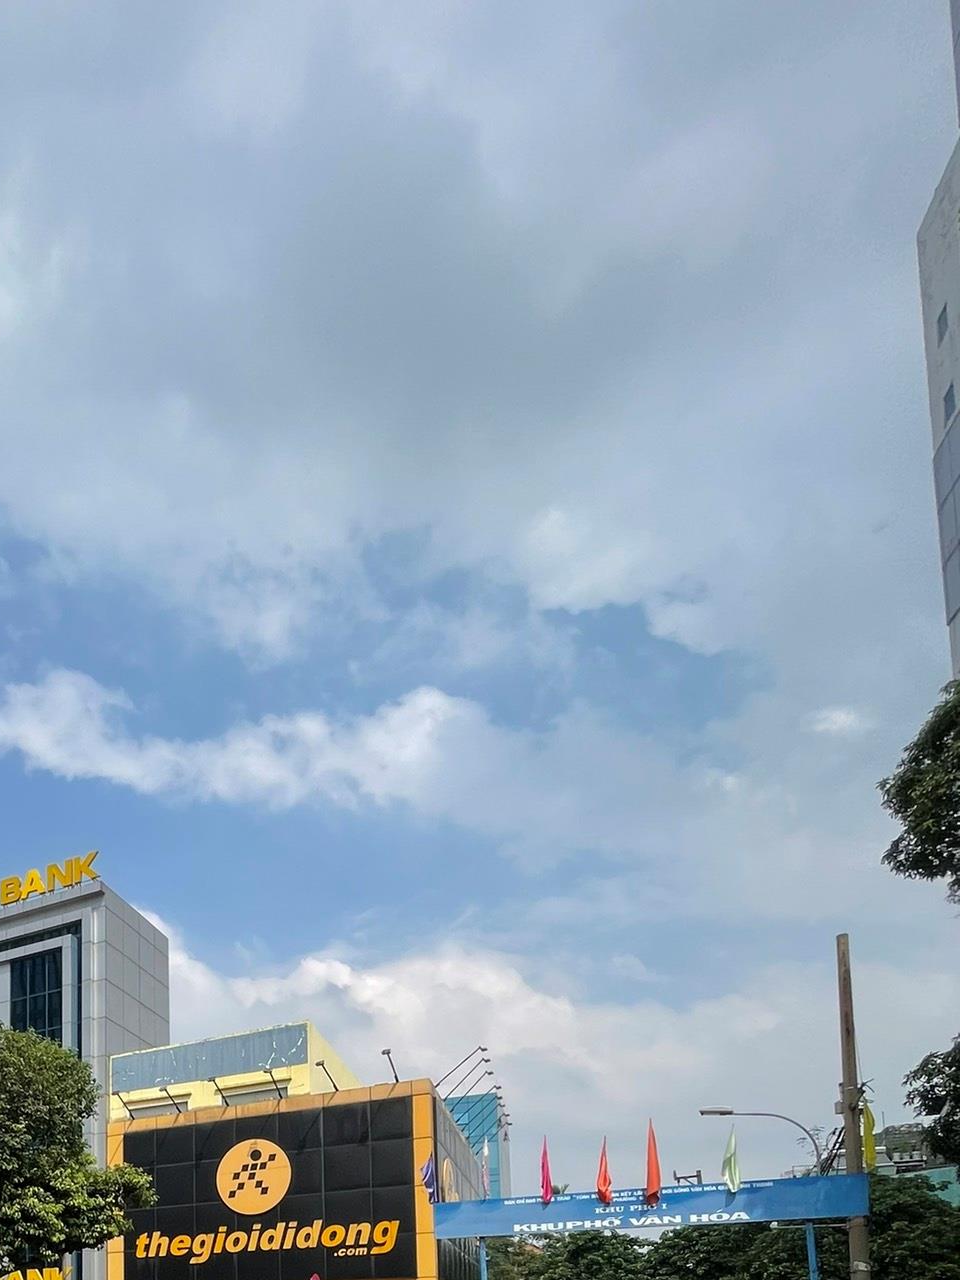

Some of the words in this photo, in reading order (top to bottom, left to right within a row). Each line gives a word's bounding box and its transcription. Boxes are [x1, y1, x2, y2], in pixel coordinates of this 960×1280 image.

[0, 850, 102, 907] BANK
[513, 1222, 561, 1232] KHU
[565, 1215, 624, 1230] PHỐ
[629, 1214, 682, 1226] VĂN
[689, 1208, 750, 1223] HÓA
[595, 1206, 624, 1214] KHU
[135, 1220, 400, 1265] thegioididong
[334, 1245, 368, 1258] .com
